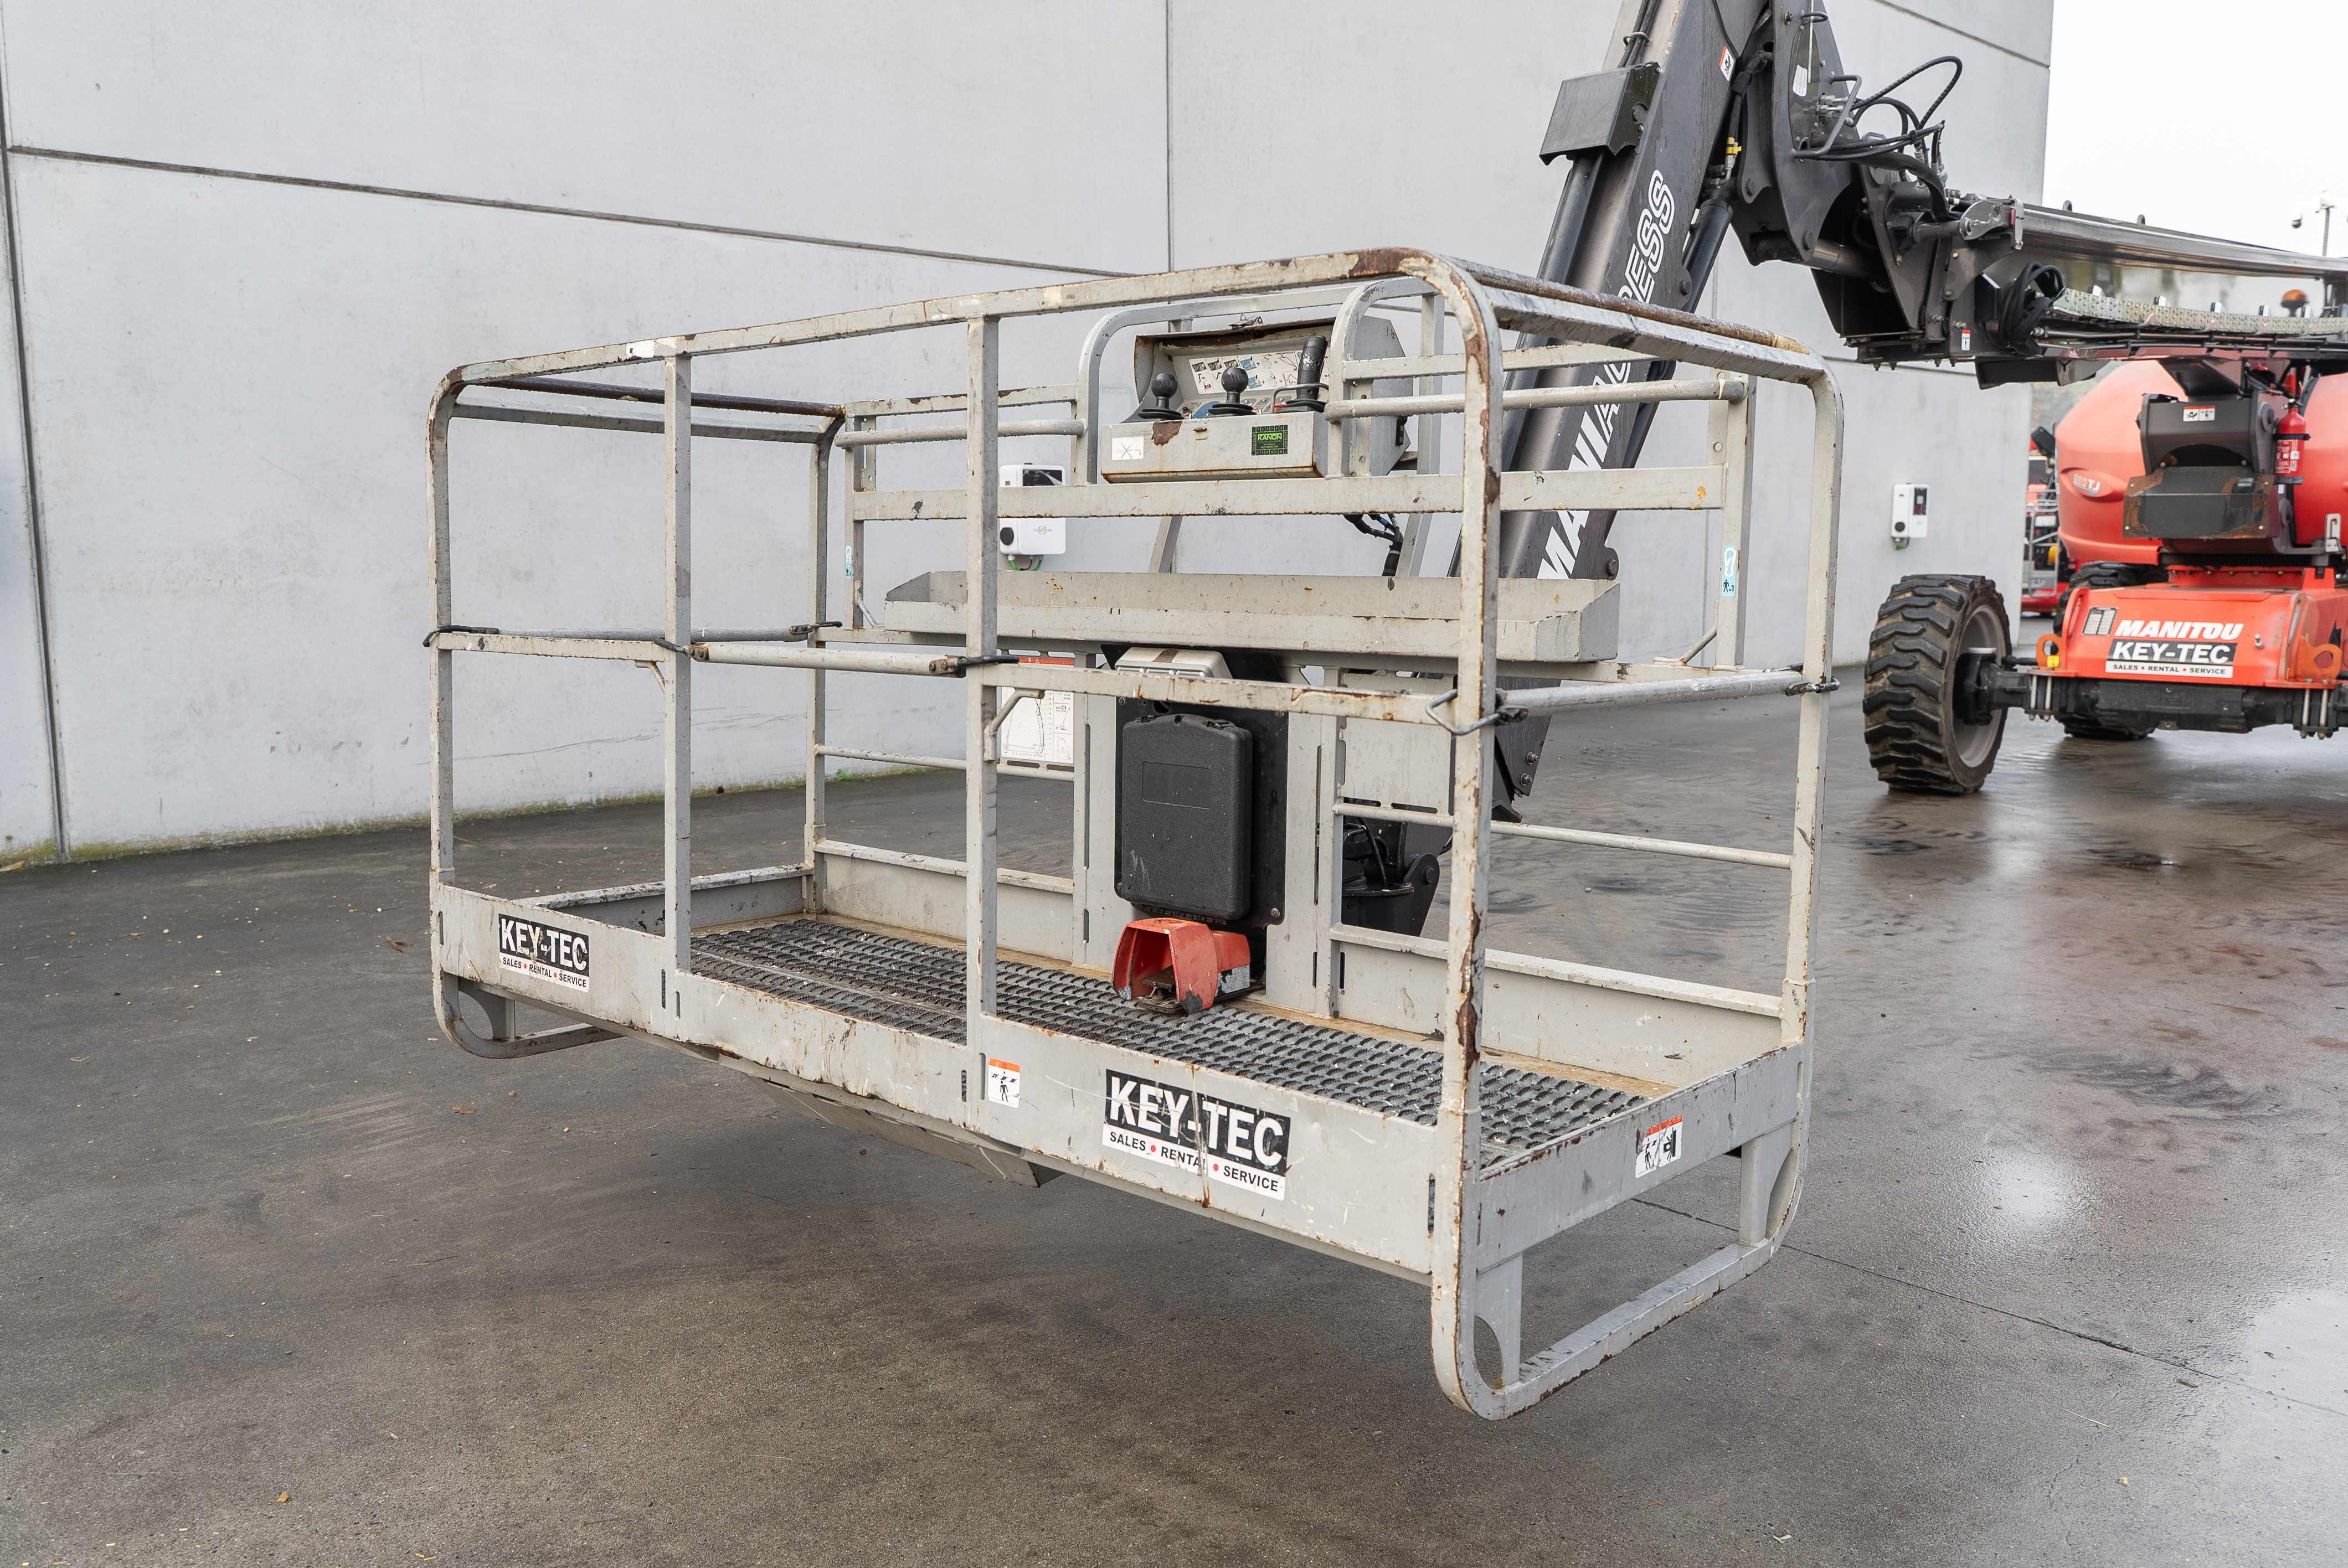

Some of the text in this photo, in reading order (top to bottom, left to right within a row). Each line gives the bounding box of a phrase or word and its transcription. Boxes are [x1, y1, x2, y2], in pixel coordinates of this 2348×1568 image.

[1257, 432, 1283, 441] KANON
[2114, 620, 2244, 640] MANITOU
[2112, 641, 2231, 664] KEY-TEC
[501, 918, 588, 971] KEY-TEC
[502, 957, 587, 988] SALES RENTAL SERVICE
[1109, 1076, 1284, 1167] KEY-TEC
[1109, 1131, 1146, 1152] SALES
[1223, 1165, 1279, 1192] SERVICE
